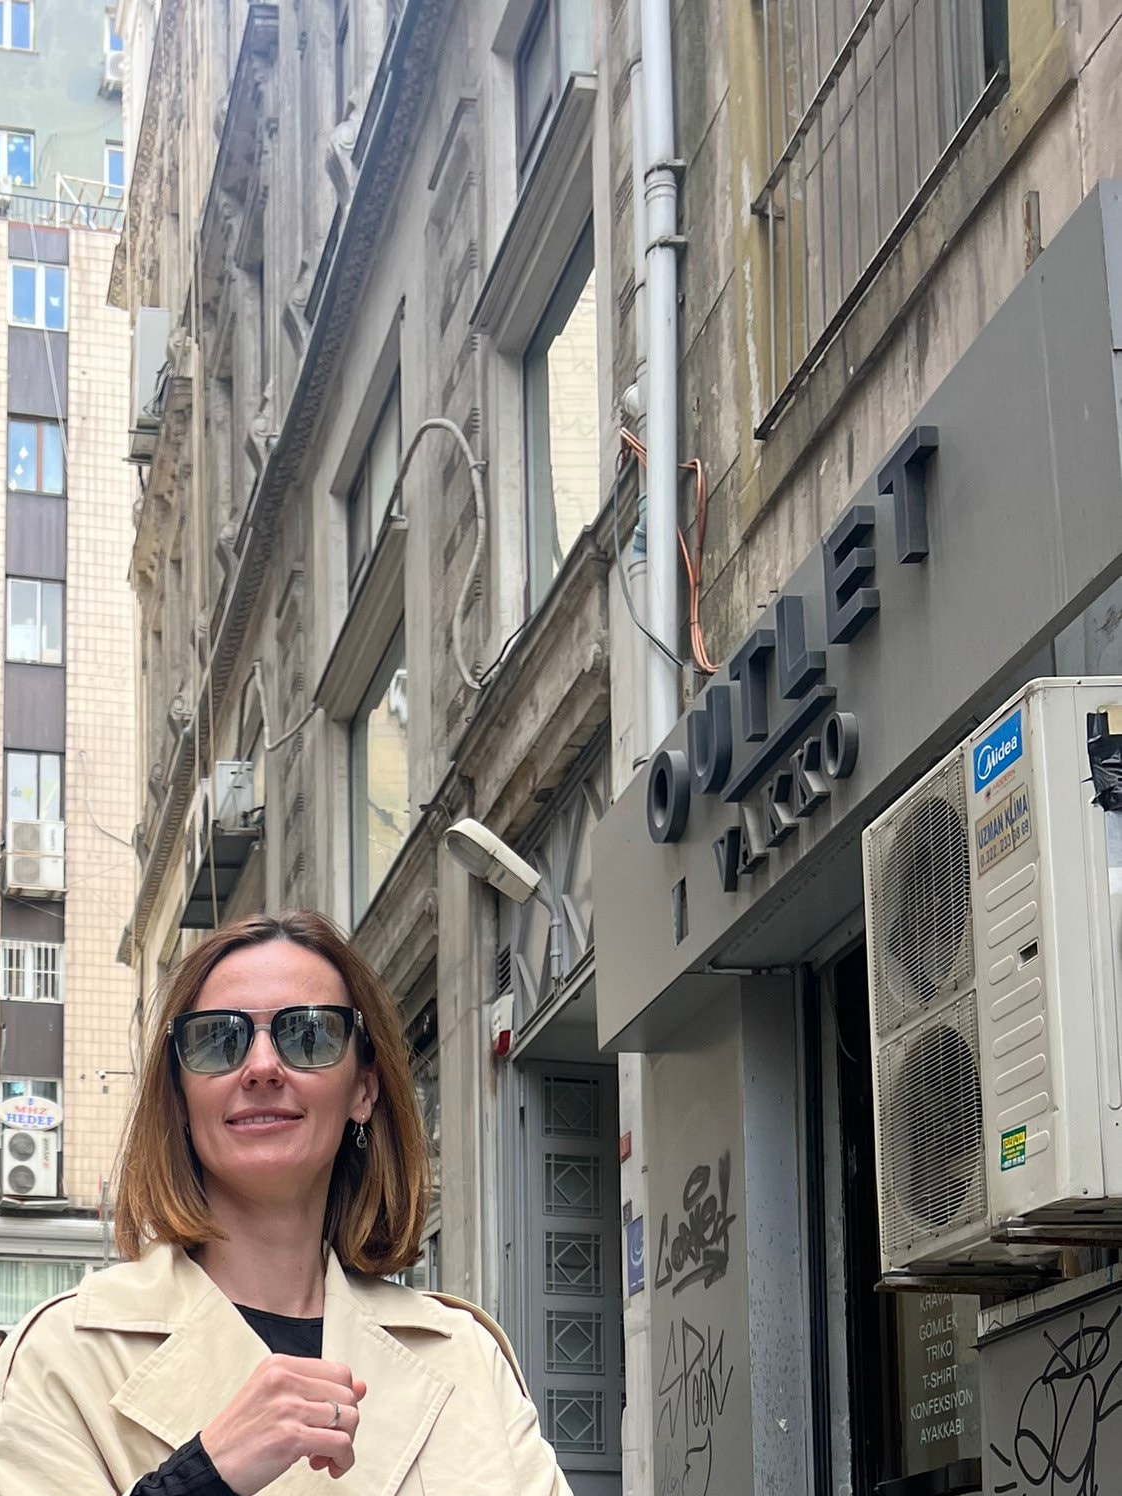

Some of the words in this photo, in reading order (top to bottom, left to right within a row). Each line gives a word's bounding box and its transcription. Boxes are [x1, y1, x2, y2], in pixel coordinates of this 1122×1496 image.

[647, 425, 938, 843] OUTLET
[978, 735, 1018, 781] Midea
[712, 711, 859, 893] VAKKO
[978, 812, 1004, 850] UZMAN
[6, 1113, 55, 1126] HEDEF
[14, 1105, 48, 1115] MHZ
[919, 1312, 958, 1341] GÖMLEK
[922, 1365, 959, 1391] T-SHIRT
[920, 1417, 965, 1445] AYAKKABI
